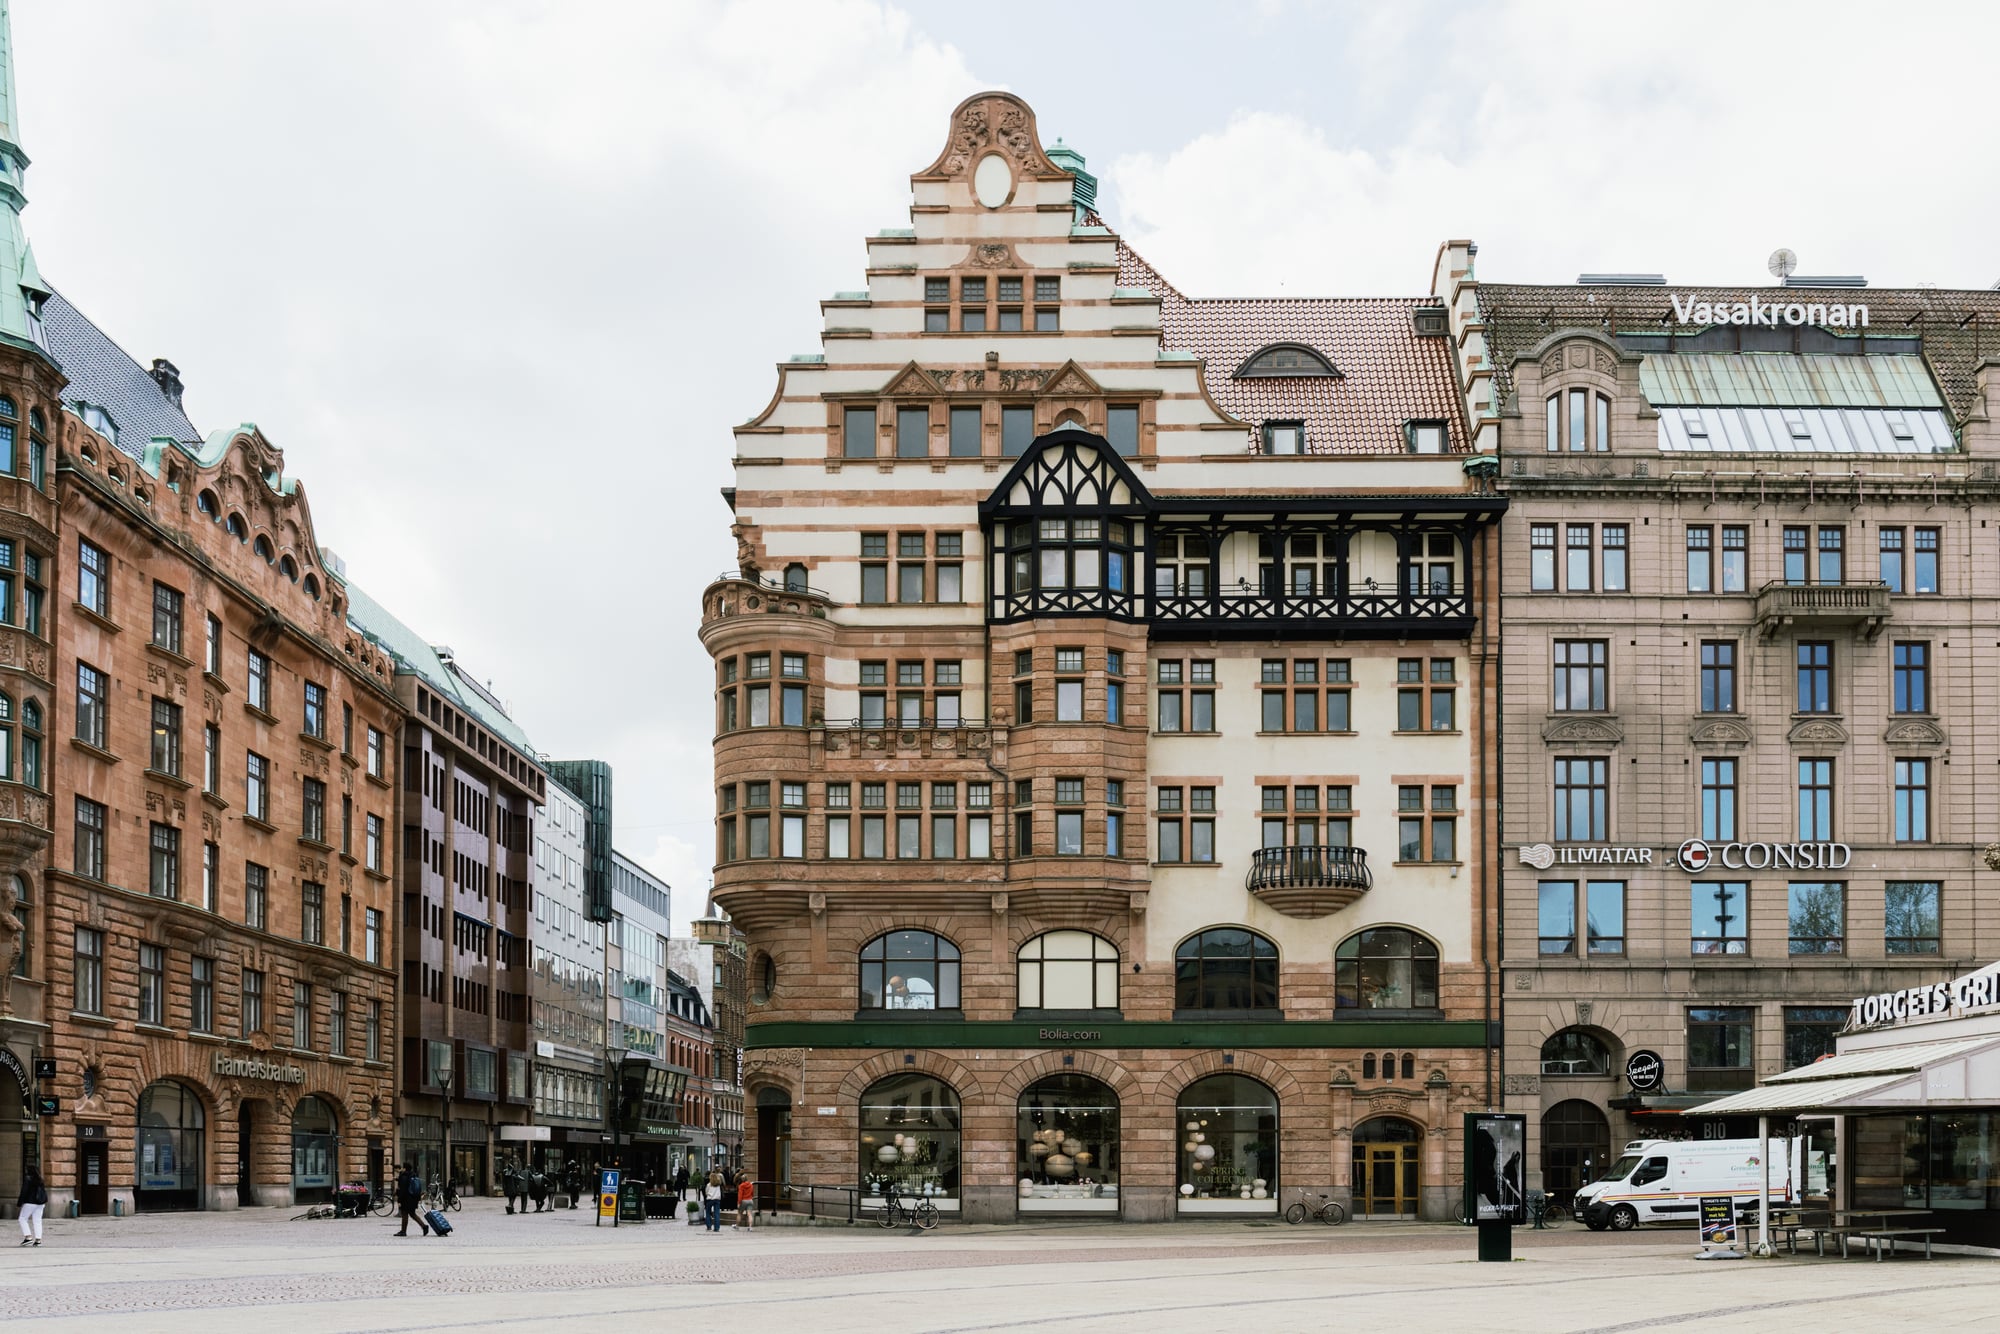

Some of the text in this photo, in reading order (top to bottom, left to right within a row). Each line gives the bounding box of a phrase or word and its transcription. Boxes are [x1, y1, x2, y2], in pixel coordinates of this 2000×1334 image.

[1670, 294, 1869, 326] Vasakronan
[1546, 461, 1614, 475] BANK
[1561, 847, 1653, 864] ILMATAR
[1721, 842, 1852, 869] CONSID
[1853, 982, 1947, 1025] TORGETS
[213, 1050, 306, 1084] Handelsbanken
[736, 1047, 744, 1087] HOTELL
[85, 1127, 94, 1136] 10
[1703, 1122, 1726, 1139] BIO
[1788, 1122, 1801, 1138] BI
[1211, 1167, 1246, 1175] SPRING
